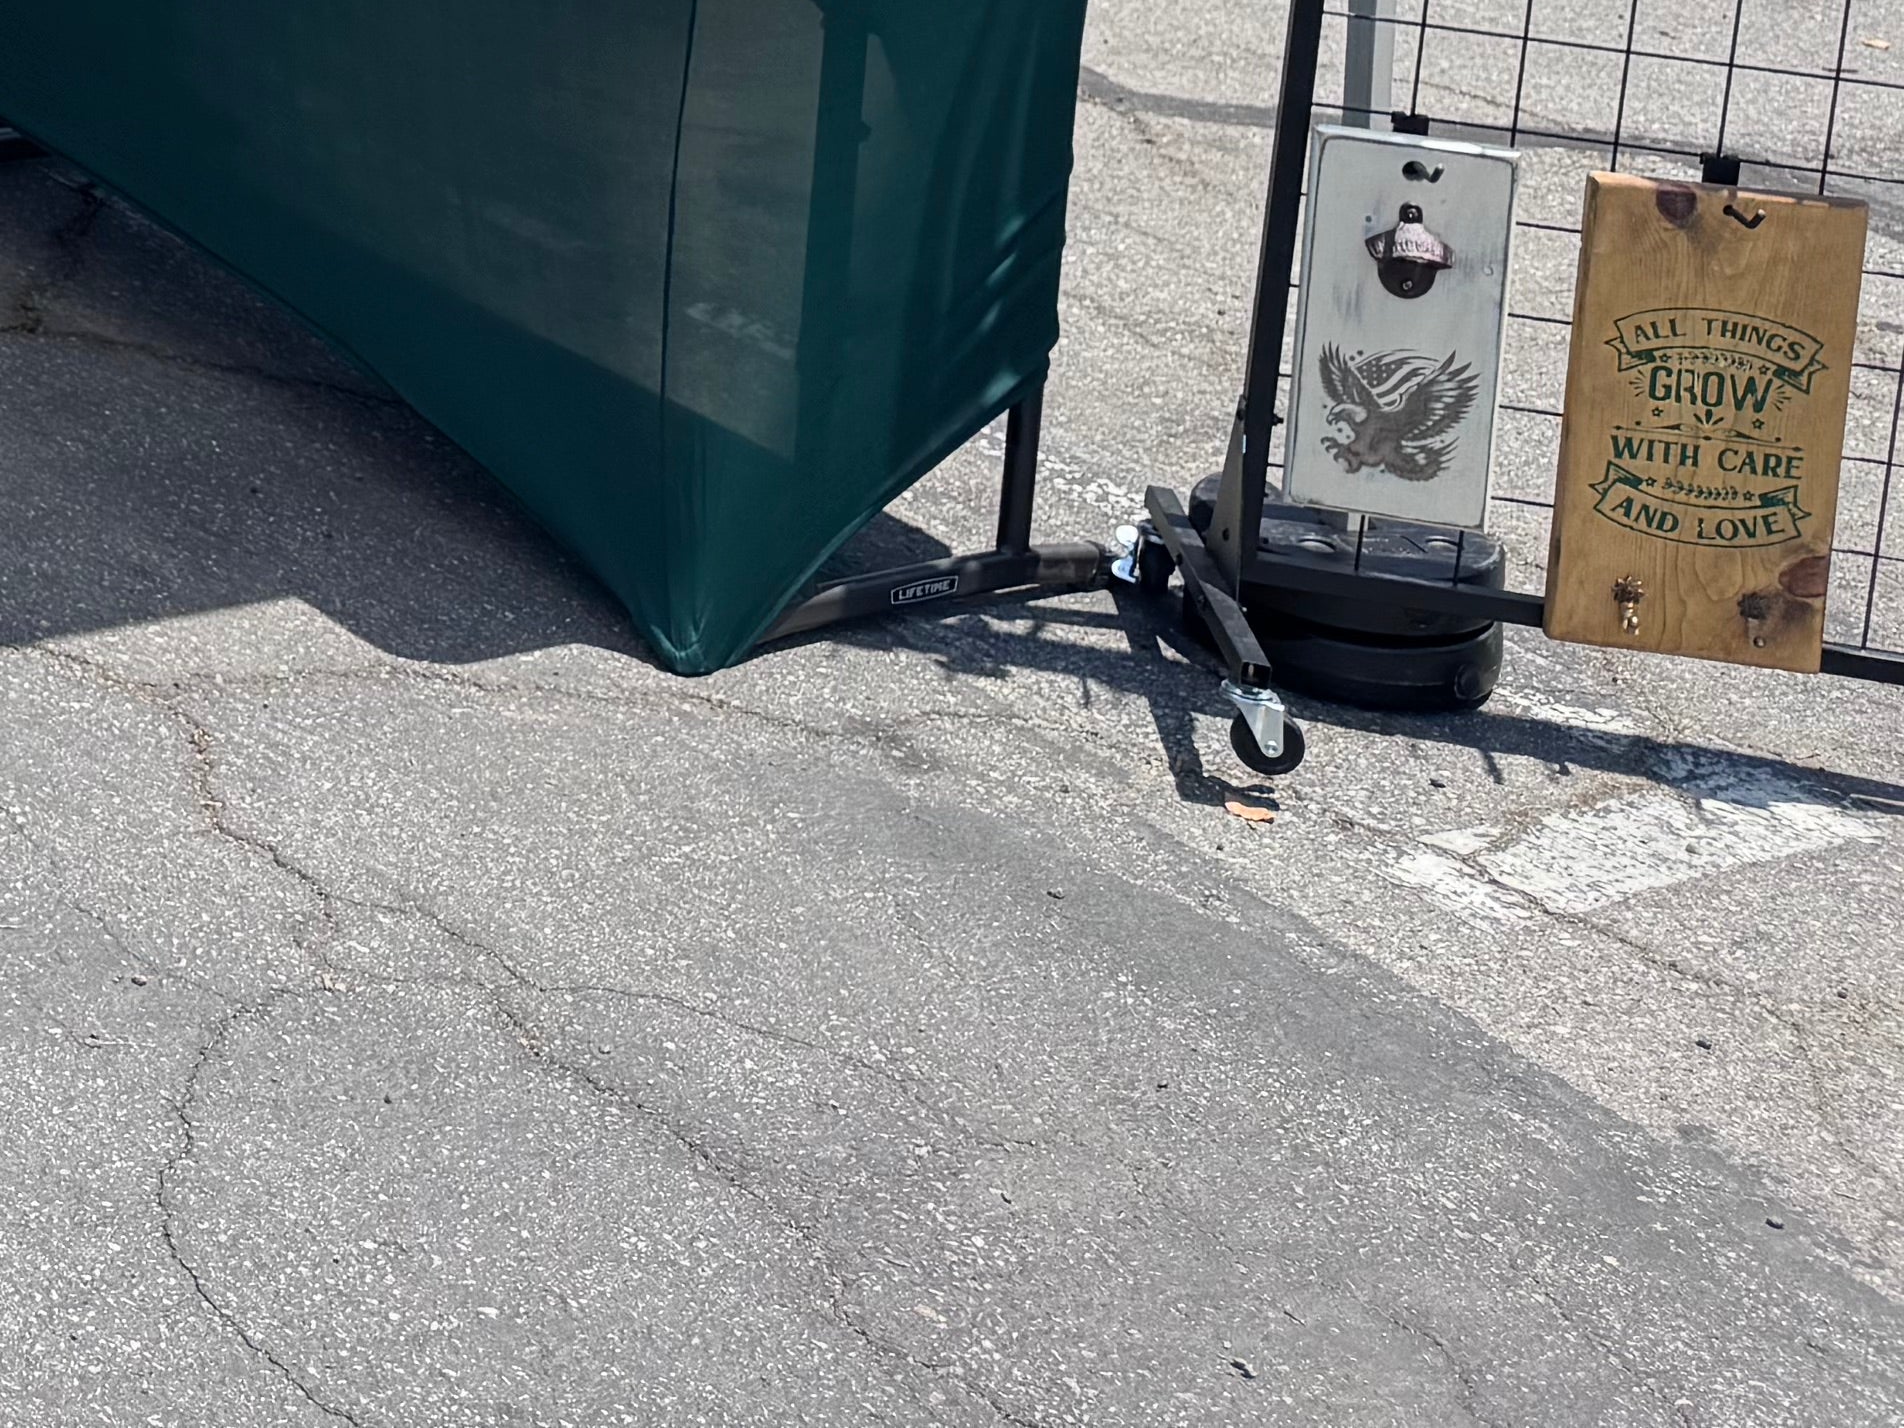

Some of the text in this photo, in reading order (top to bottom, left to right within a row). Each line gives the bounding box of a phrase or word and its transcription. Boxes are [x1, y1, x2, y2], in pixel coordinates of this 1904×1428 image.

[1633, 316, 1809, 362] ALL THINGS
[1648, 367, 1774, 414] GROW
[1610, 433, 1805, 480] WITH CARE
[1615, 495, 1789, 541] AND LOVE
[898, 580, 951, 601] LIFETIME
